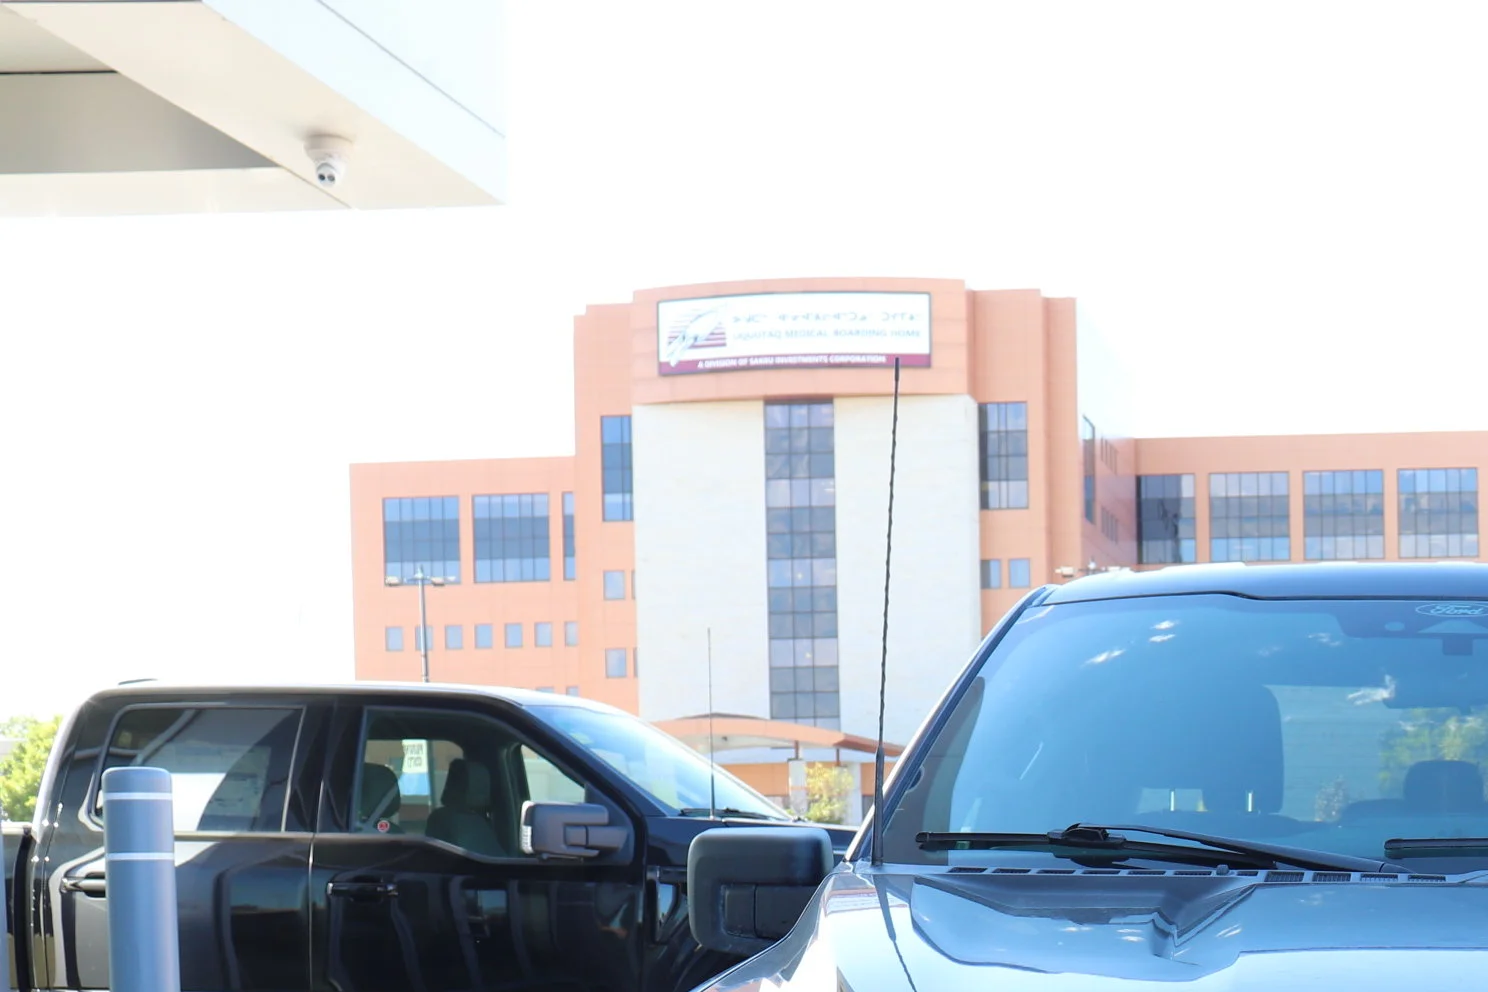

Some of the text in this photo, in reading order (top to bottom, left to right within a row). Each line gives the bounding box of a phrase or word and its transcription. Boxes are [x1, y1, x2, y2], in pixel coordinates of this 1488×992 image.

[704, 358, 737, 368] DIVISION
[829, 354, 886, 364] CORPORATION
[1430, 604, 1484, 615] Ford
